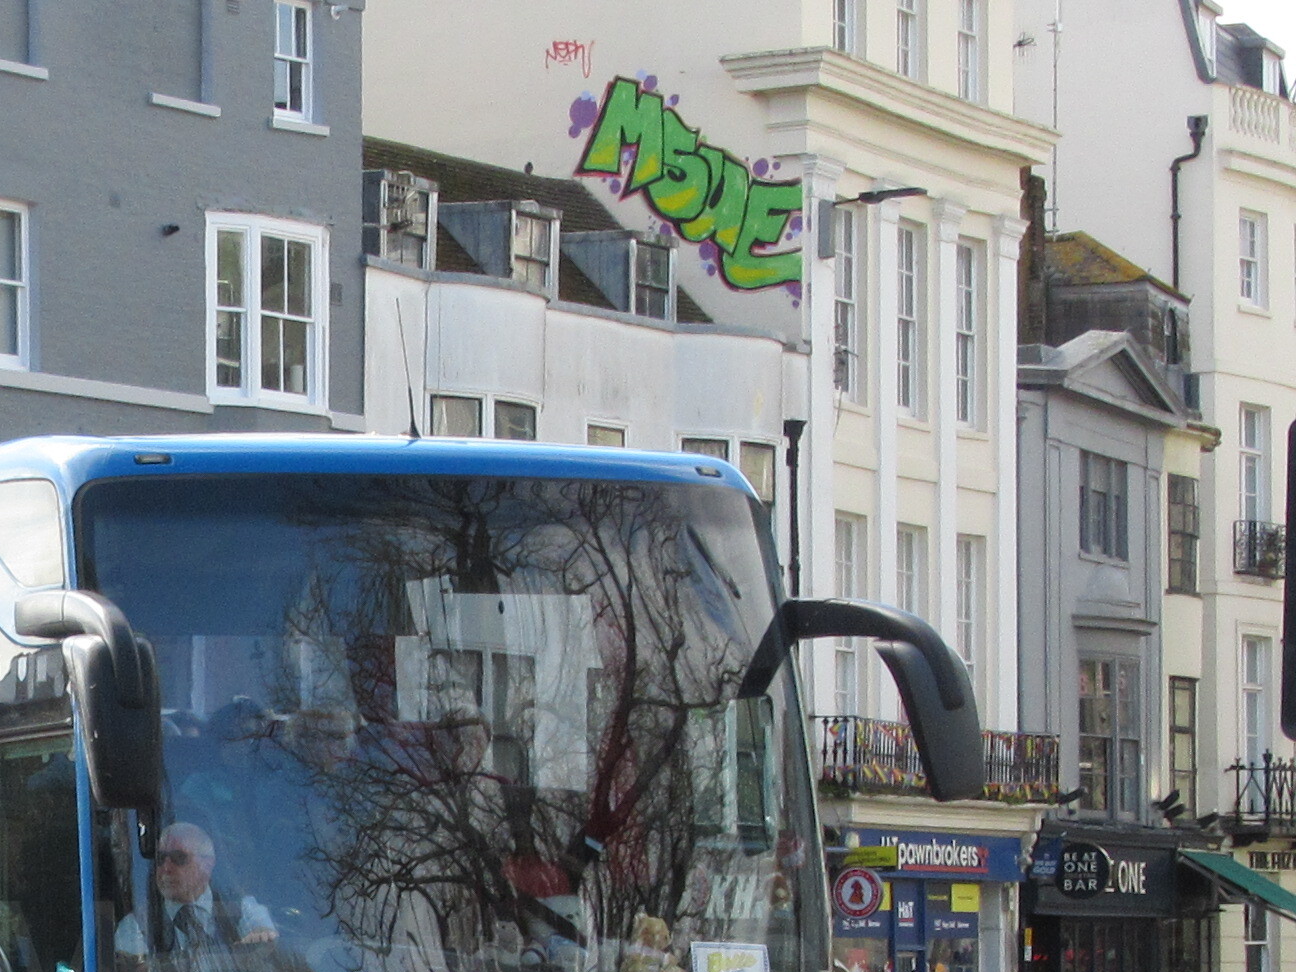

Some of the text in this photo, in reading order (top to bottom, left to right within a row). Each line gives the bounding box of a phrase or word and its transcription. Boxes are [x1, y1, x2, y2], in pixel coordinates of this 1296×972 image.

[898, 839, 978, 870] pawnbrokers
[1064, 852, 1097, 861] BE AT
[1064, 861, 1097, 873] ONE
[1118, 861, 1146, 894] ONE
[1064, 879, 1097, 891] BAR
